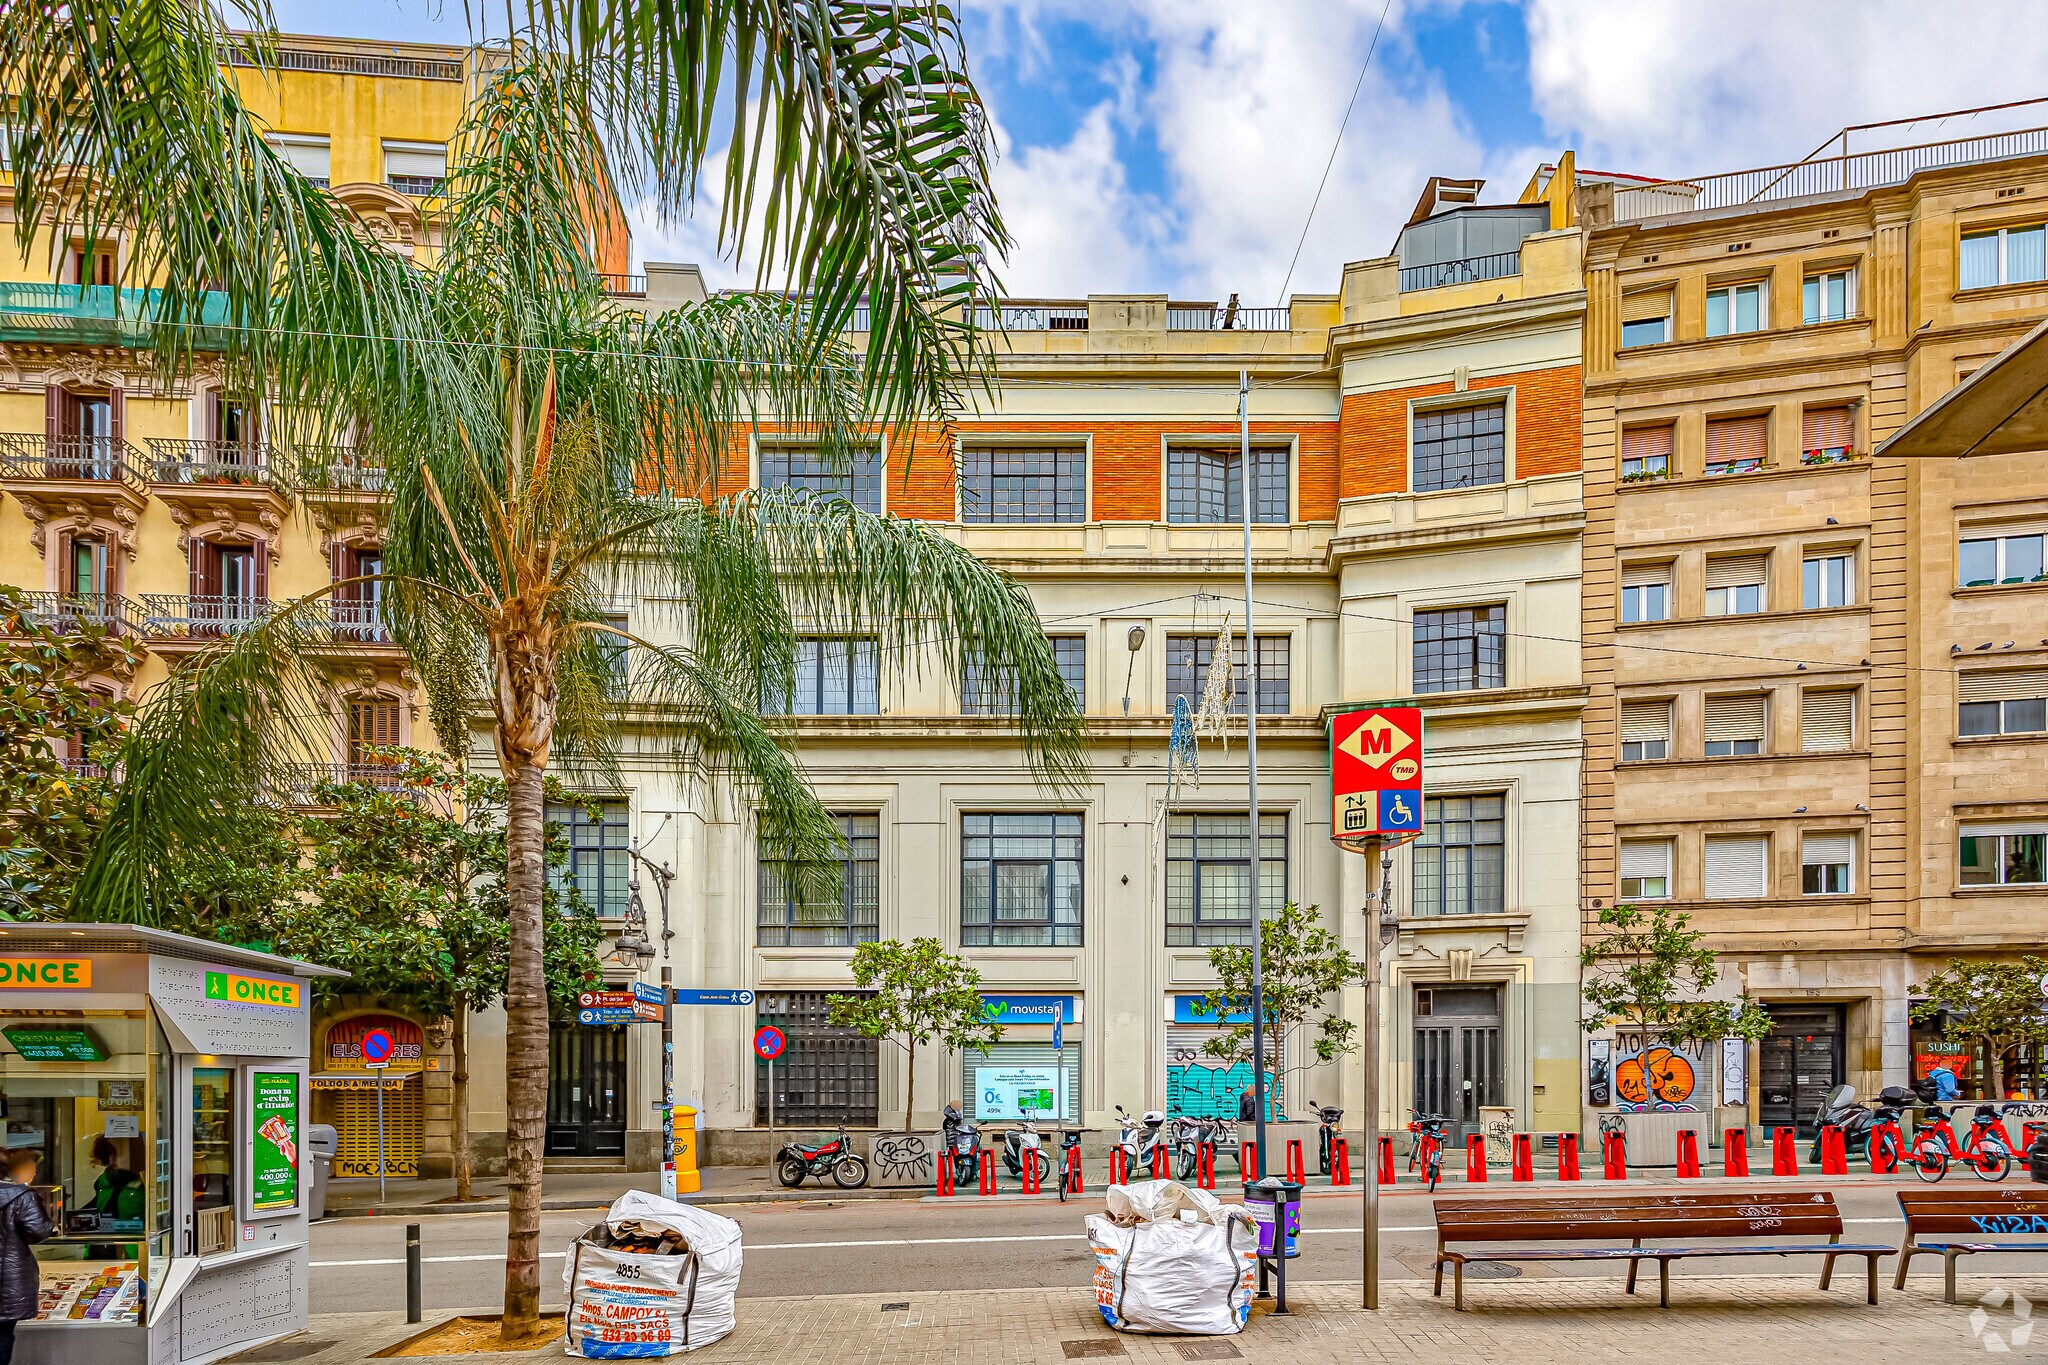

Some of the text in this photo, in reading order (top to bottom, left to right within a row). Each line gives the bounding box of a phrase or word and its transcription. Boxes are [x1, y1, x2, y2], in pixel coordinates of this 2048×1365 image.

[1361, 728, 1391, 755] M
[1396, 766, 1414, 774] TMB
[0, 962, 80, 983] ONCE
[235, 980, 293, 1004] ONCE
[1010, 1005, 1054, 1014] movista
[333, 1043, 361, 1058] ELS
[1928, 1043, 1960, 1052] SUSHI
[311, 1080, 349, 1088] TOLDOS
[615, 1263, 641, 1279] 4855
[584, 1279, 677, 1297] PROHIBIDO PONER FIBROCEMENTO
[582, 1299, 604, 1317] Hnos.
[606, 1304, 653, 1321] CAMPOY
[579, 1314, 592, 1324] Els
[615, 1321, 637, 1330] Dels
[640, 1318, 670, 1330] SACS
[602, 1328, 622, 1343] 932
[657, 1328, 672, 1343] 89
